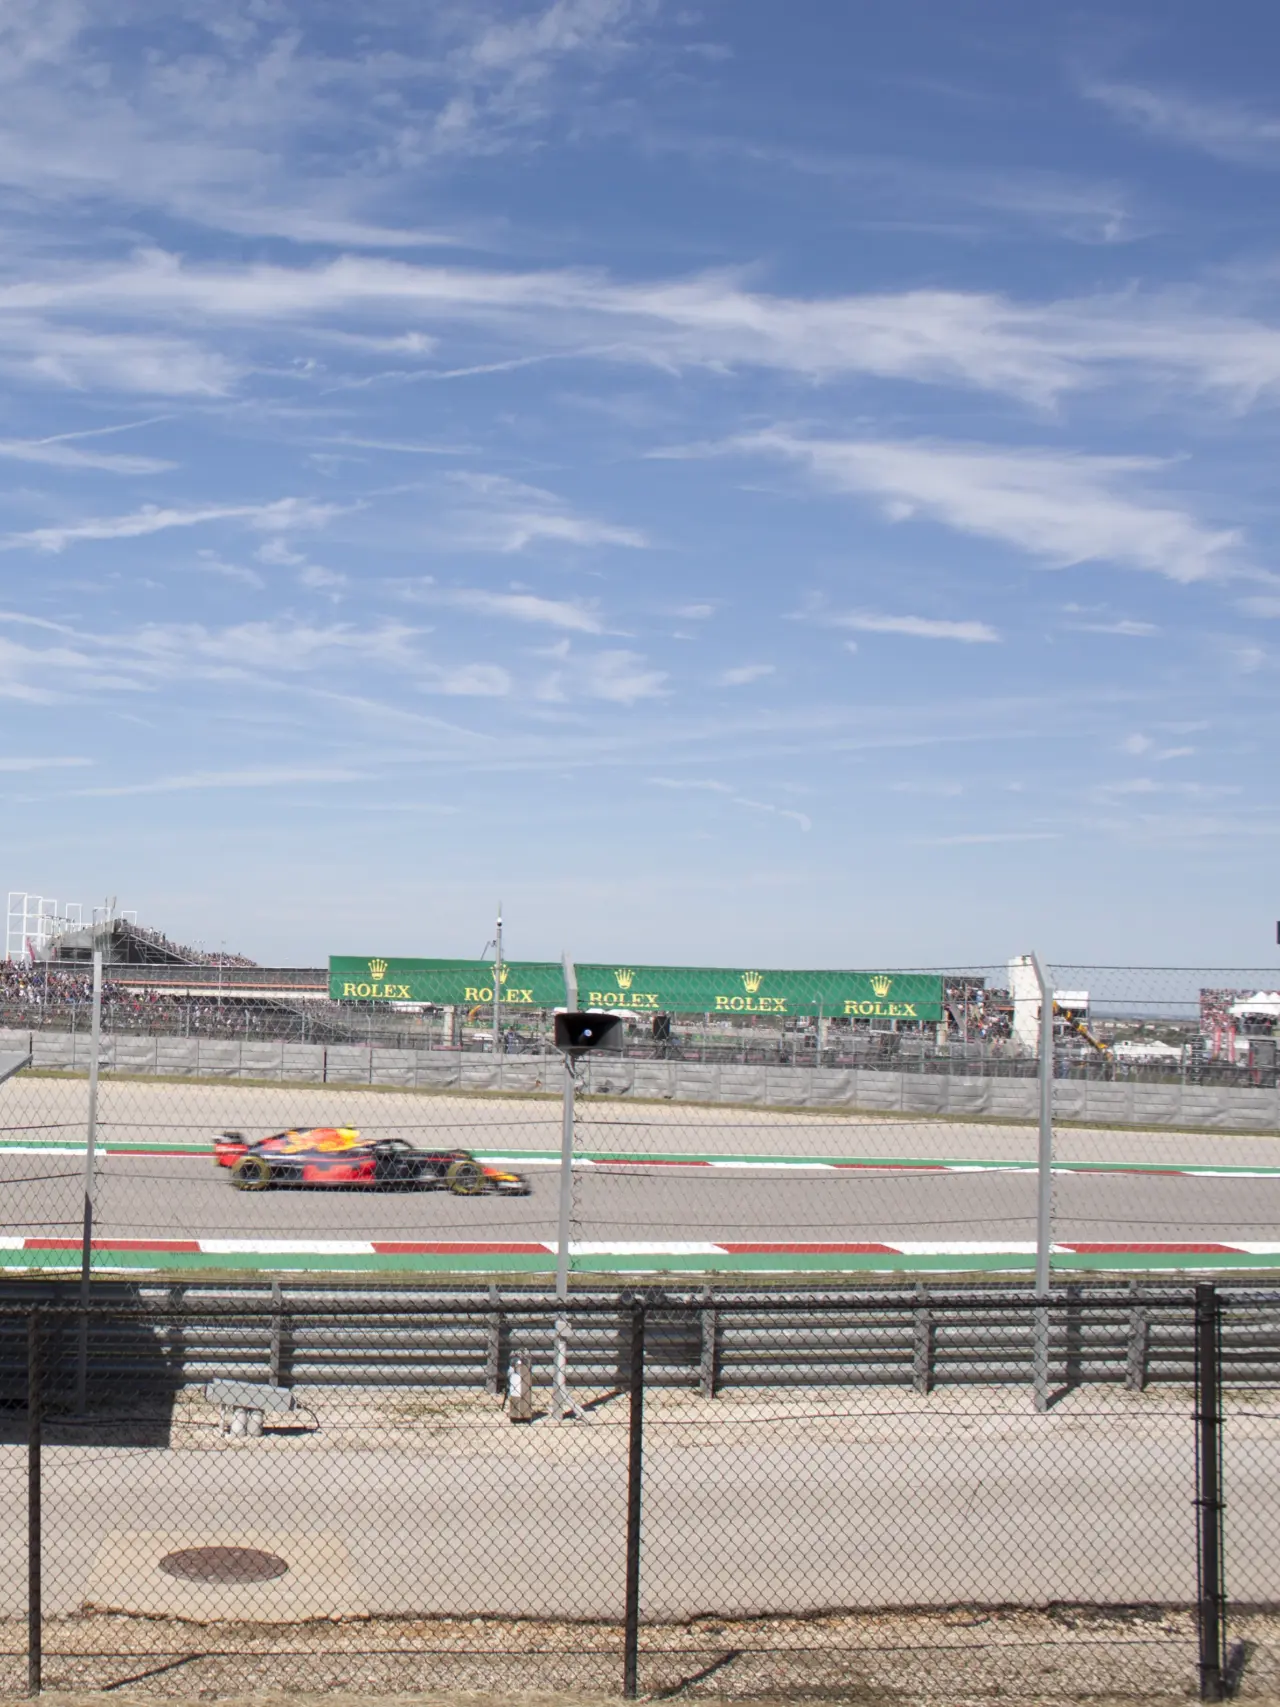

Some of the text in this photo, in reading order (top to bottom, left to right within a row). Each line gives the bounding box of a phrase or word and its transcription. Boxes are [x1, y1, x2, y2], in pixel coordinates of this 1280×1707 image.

[343, 983, 411, 998] ROLEX
[588, 992, 659, 1007] ROLEX
[715, 996, 788, 1012] ROLEX
[844, 1000, 918, 1016] ROLEX
